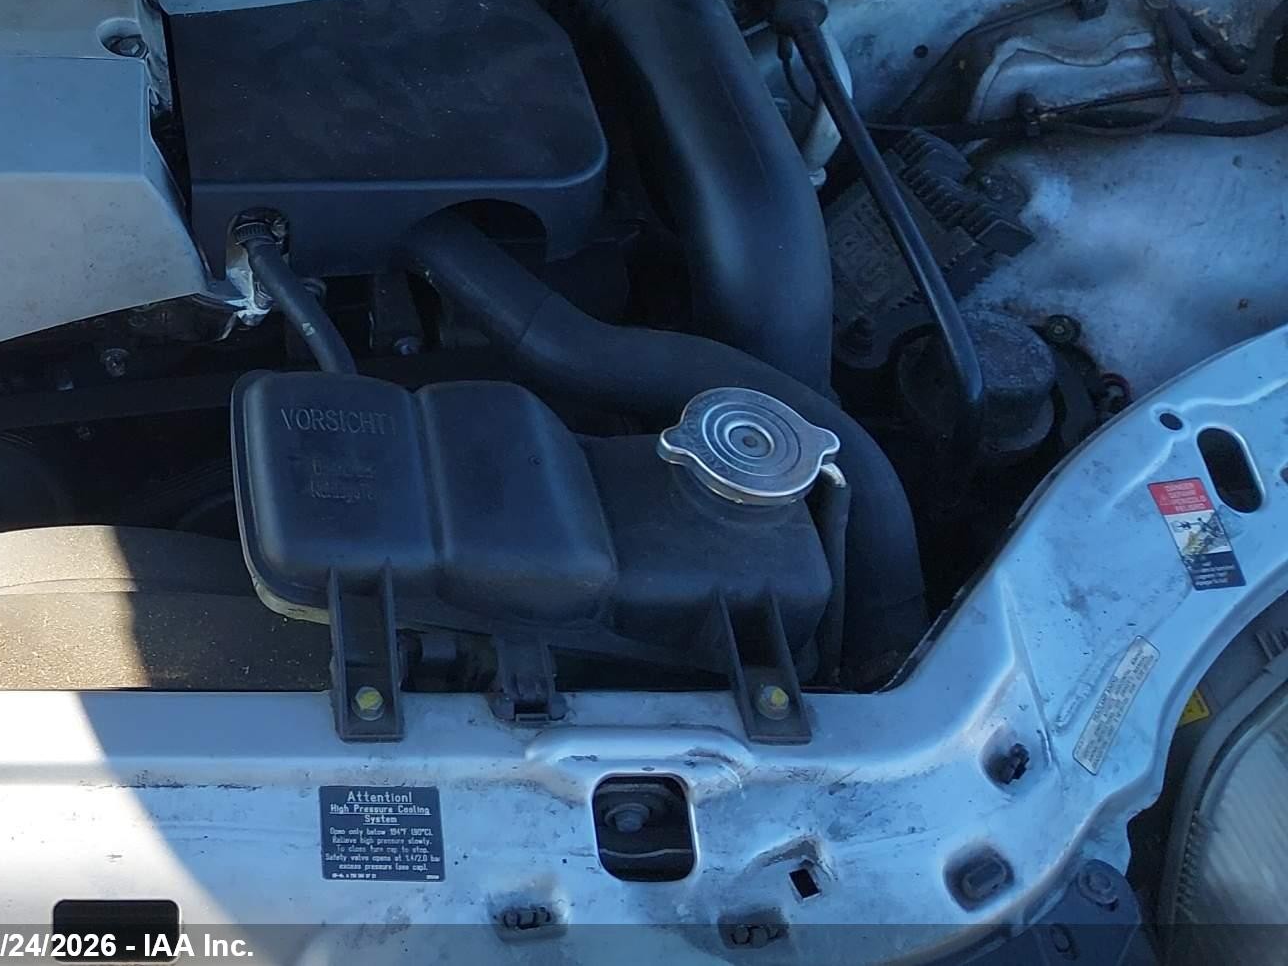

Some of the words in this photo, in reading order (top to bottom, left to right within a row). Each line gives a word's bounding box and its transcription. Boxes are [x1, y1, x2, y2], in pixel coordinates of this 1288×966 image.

[347, 790, 412, 803] Attention!
[330, 804, 349, 814] High
[353, 804, 393, 813] Pressure
[397, 805, 431, 815] Cooling
[364, 814, 398, 824] System
